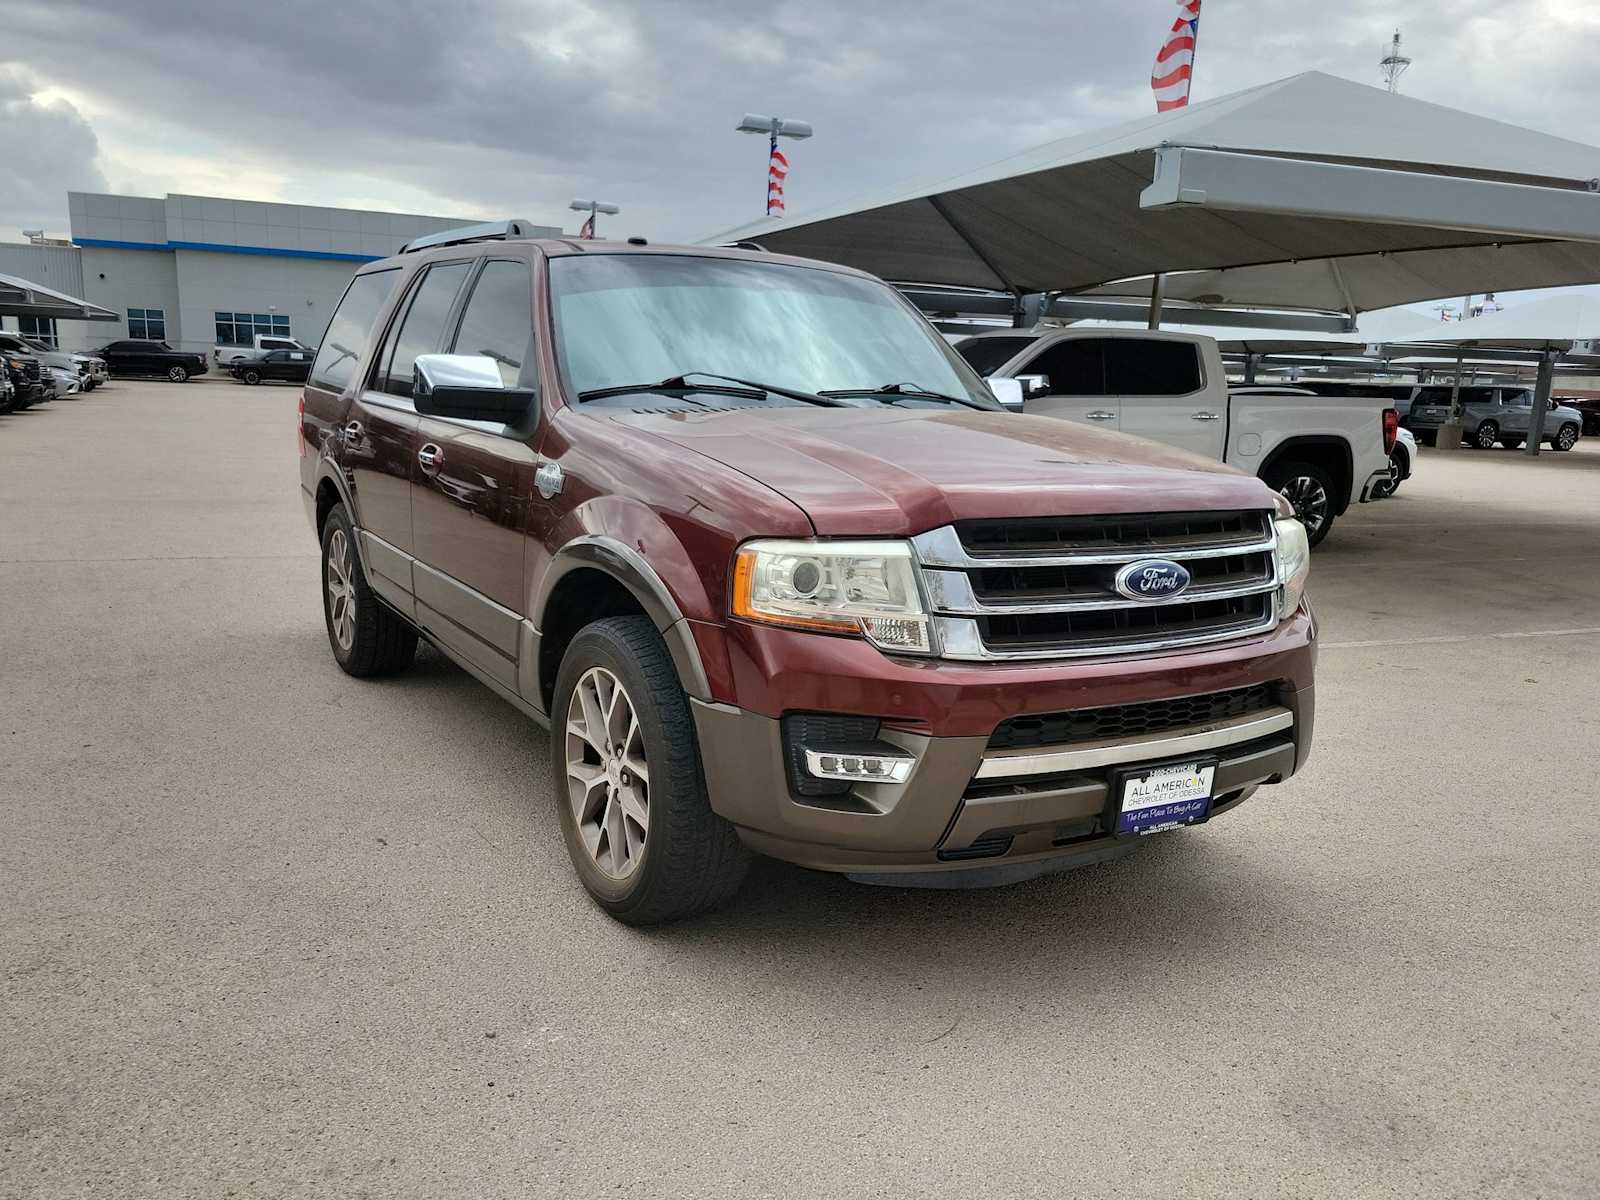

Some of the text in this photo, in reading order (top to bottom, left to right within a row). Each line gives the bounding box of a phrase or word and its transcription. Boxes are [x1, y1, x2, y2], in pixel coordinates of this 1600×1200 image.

[1140, 567, 1179, 591] Ford
[1128, 787, 1205, 807] CHEVROLET OF ODESSA
[1132, 785, 1151, 797] ALL
[1126, 813, 1137, 823] The
[1150, 808, 1166, 818] Place
[1166, 806, 1174, 816] To
[1173, 804, 1186, 815] Buy
